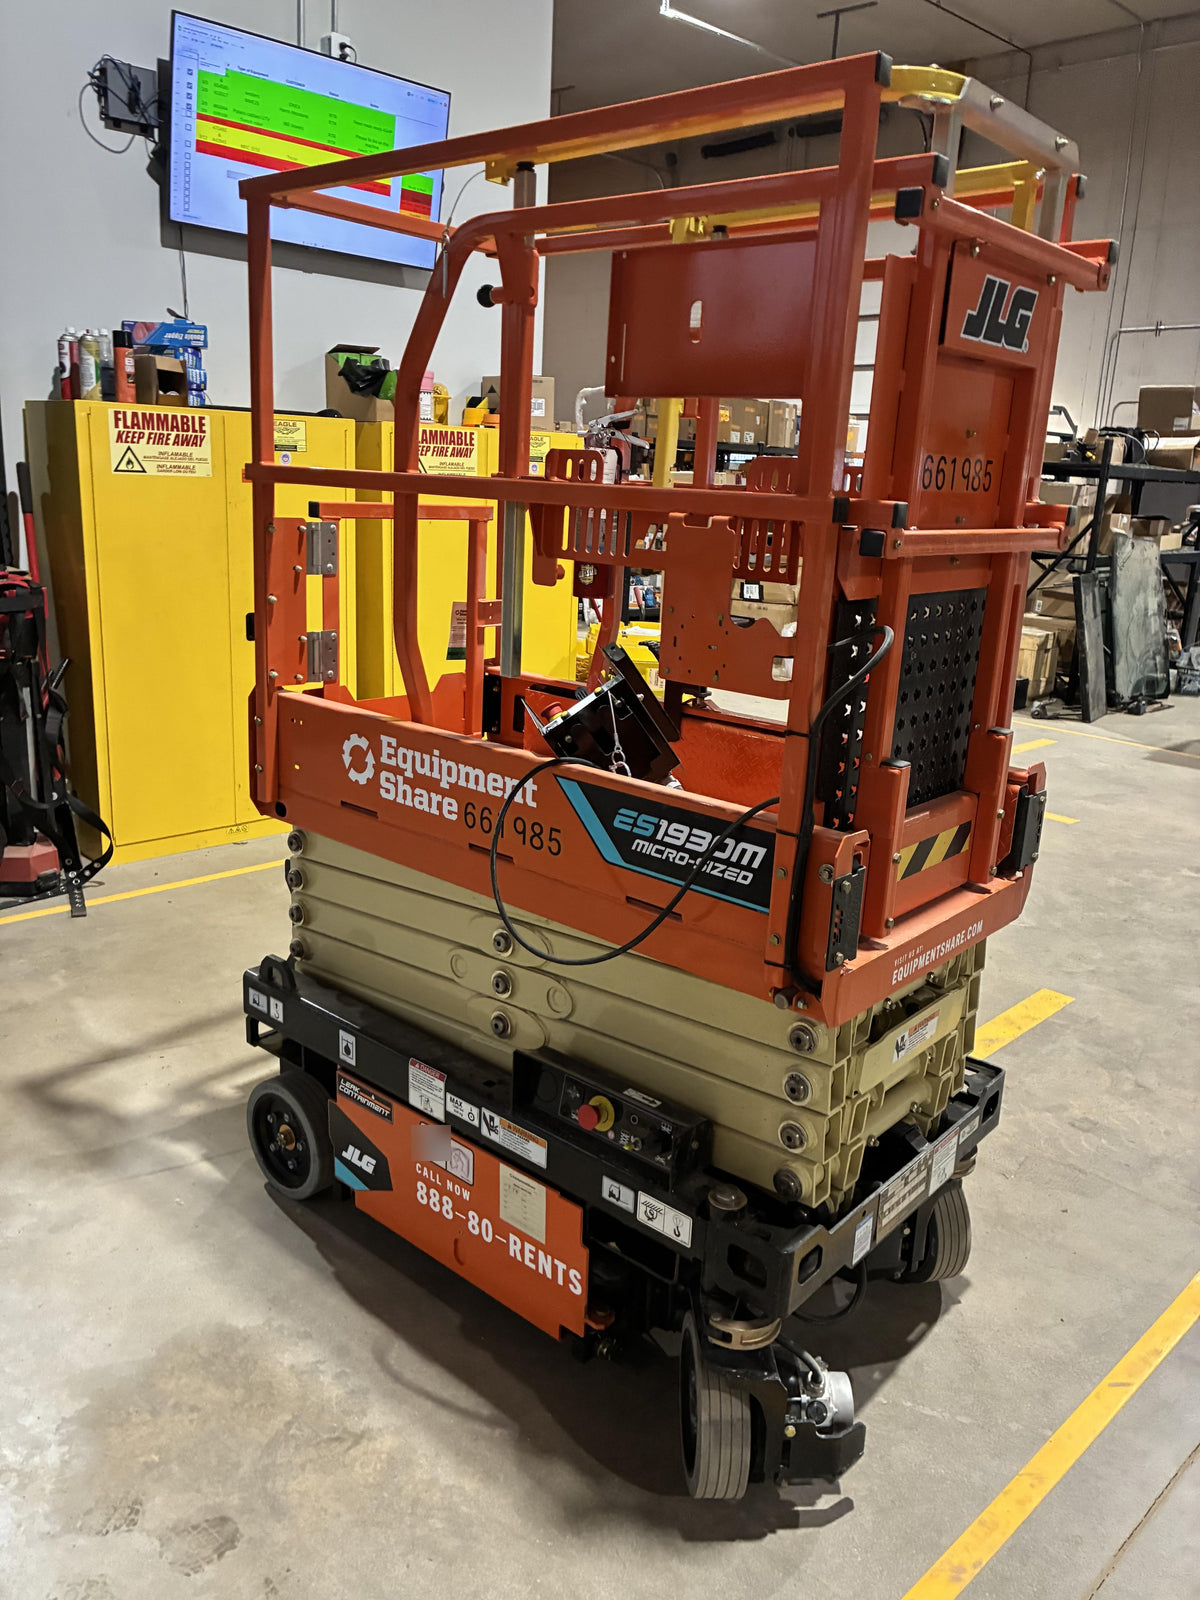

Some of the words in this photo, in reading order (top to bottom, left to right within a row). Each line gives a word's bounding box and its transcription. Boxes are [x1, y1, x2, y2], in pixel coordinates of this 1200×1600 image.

[960, 274, 1039, 352] JLG
[114, 410, 206, 433] FLAMMABLE
[115, 430, 145, 444] KEEP
[146, 432, 172, 446] FIRE
[172, 433, 206, 447] AWAY
[431, 446, 450, 457] FIRE
[449, 447, 474, 458] AWAY
[921, 454, 994, 493] 661985
[380, 734, 538, 808] Equipment
[379, 770, 458, 821] Share
[891, 919, 984, 986] EQUIPMENTSHARE.COM
[894, 953, 908, 967] VISIT
[908, 949, 915, 959] US
[340, 1078, 361, 1093] LEAK
[420, 1064, 441, 1079] DANGER
[341, 1144, 377, 1175] JLG
[415, 1162, 442, 1186] CALL
[446, 1179, 471, 1202] NOW
[416, 1181, 583, 1296] 888-80-RENTS
